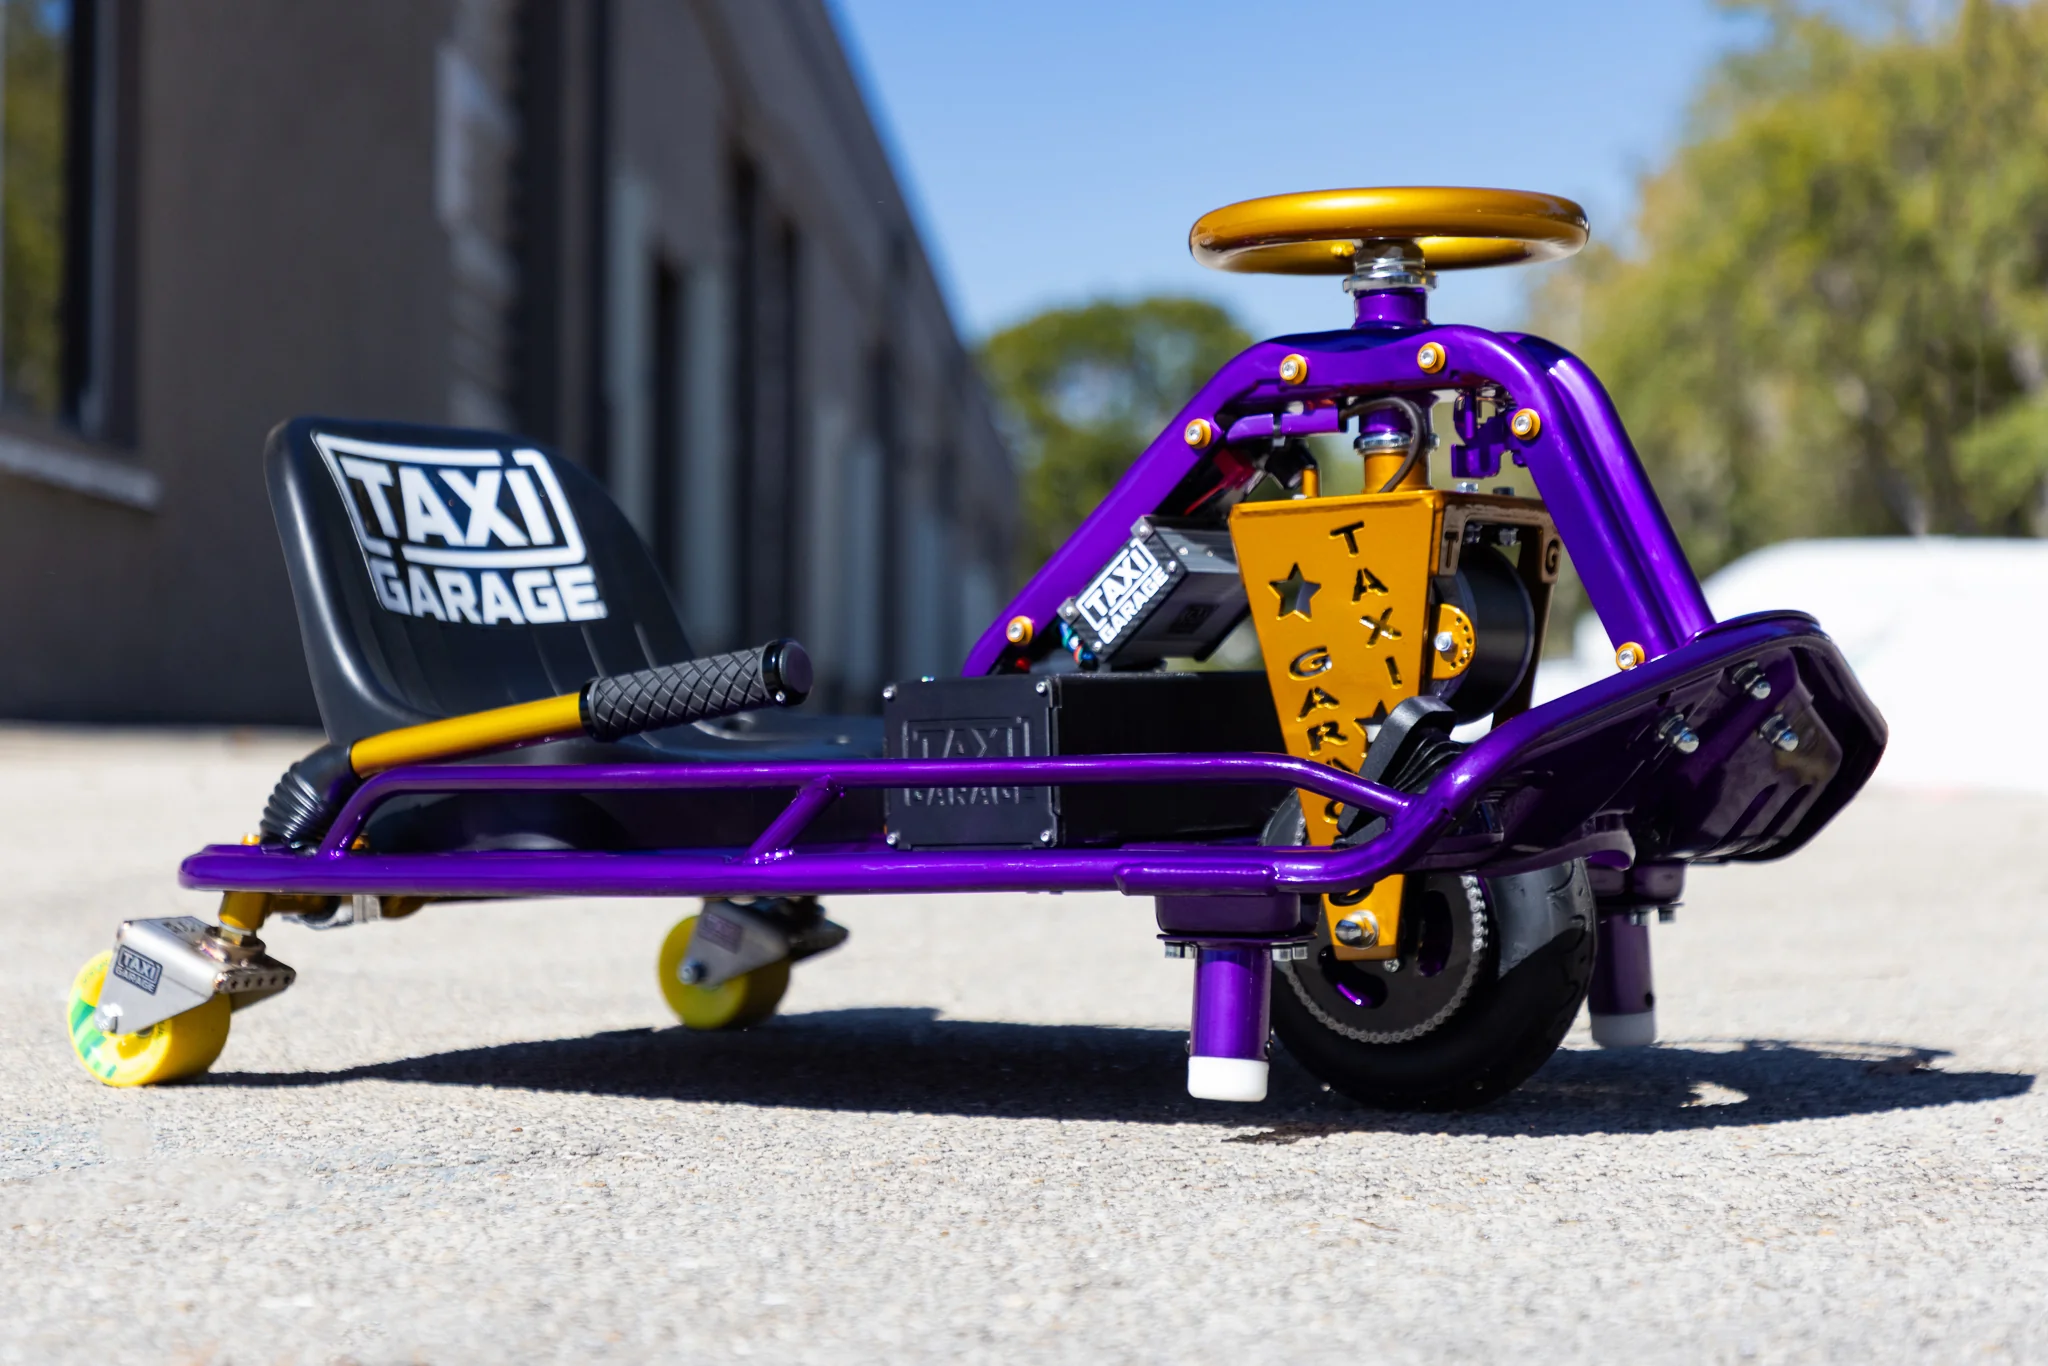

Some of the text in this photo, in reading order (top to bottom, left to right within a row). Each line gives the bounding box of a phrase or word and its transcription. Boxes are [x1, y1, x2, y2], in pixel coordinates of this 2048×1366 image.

[339, 457, 555, 547] TAXI
[367, 556, 608, 625] GARAGE
[1083, 549, 1149, 618] TAXI
[1097, 565, 1169, 645] GARAGE
[115, 966, 156, 993] GARAGE
[122, 952, 157, 980] TAXI
